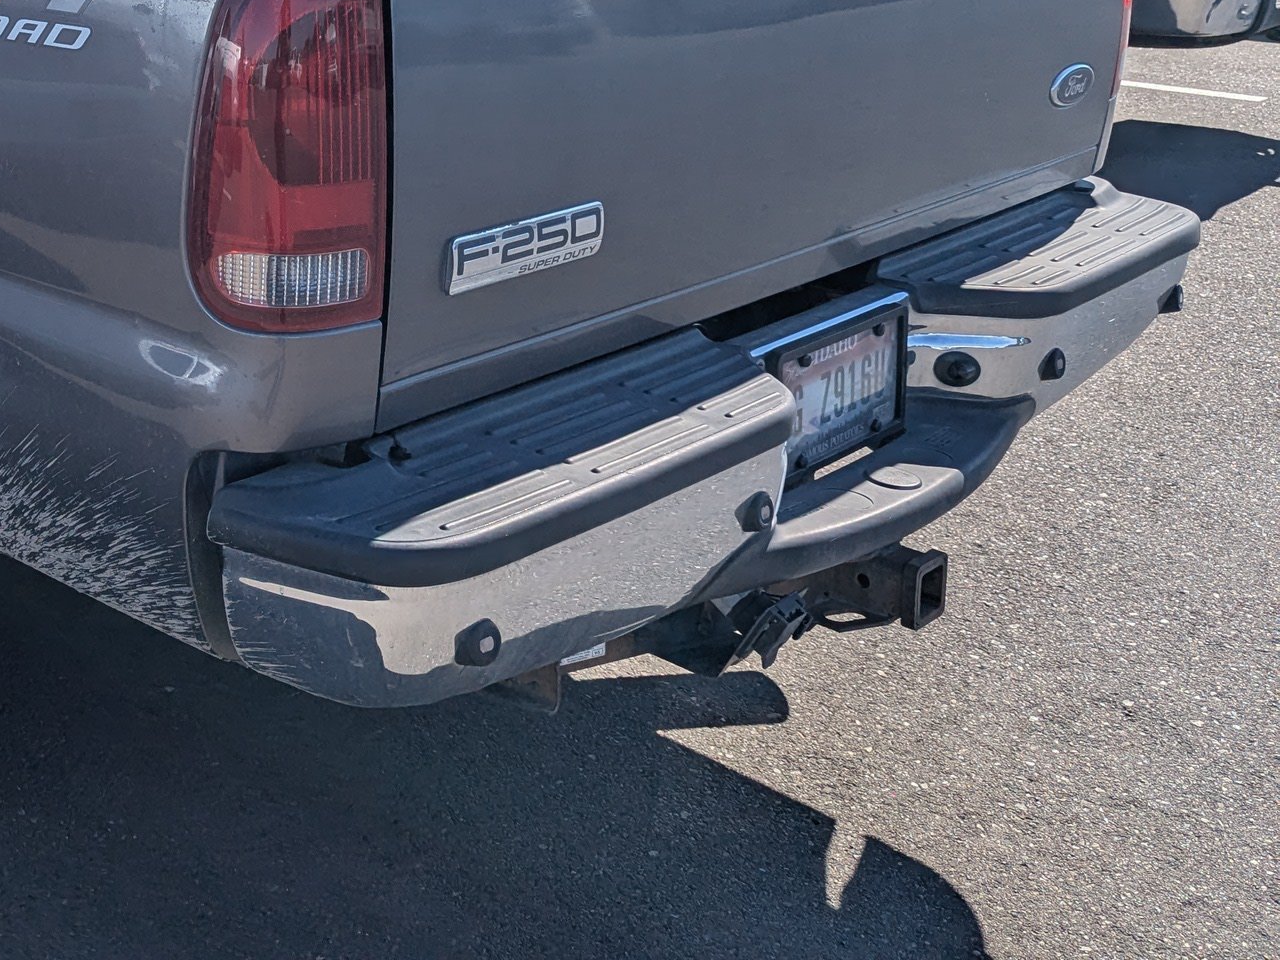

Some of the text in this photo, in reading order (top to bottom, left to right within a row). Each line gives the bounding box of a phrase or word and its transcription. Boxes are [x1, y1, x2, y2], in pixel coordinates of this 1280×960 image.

[456, 206, 602, 276] F-250
[518, 244, 598, 274] SUPER DUTY
